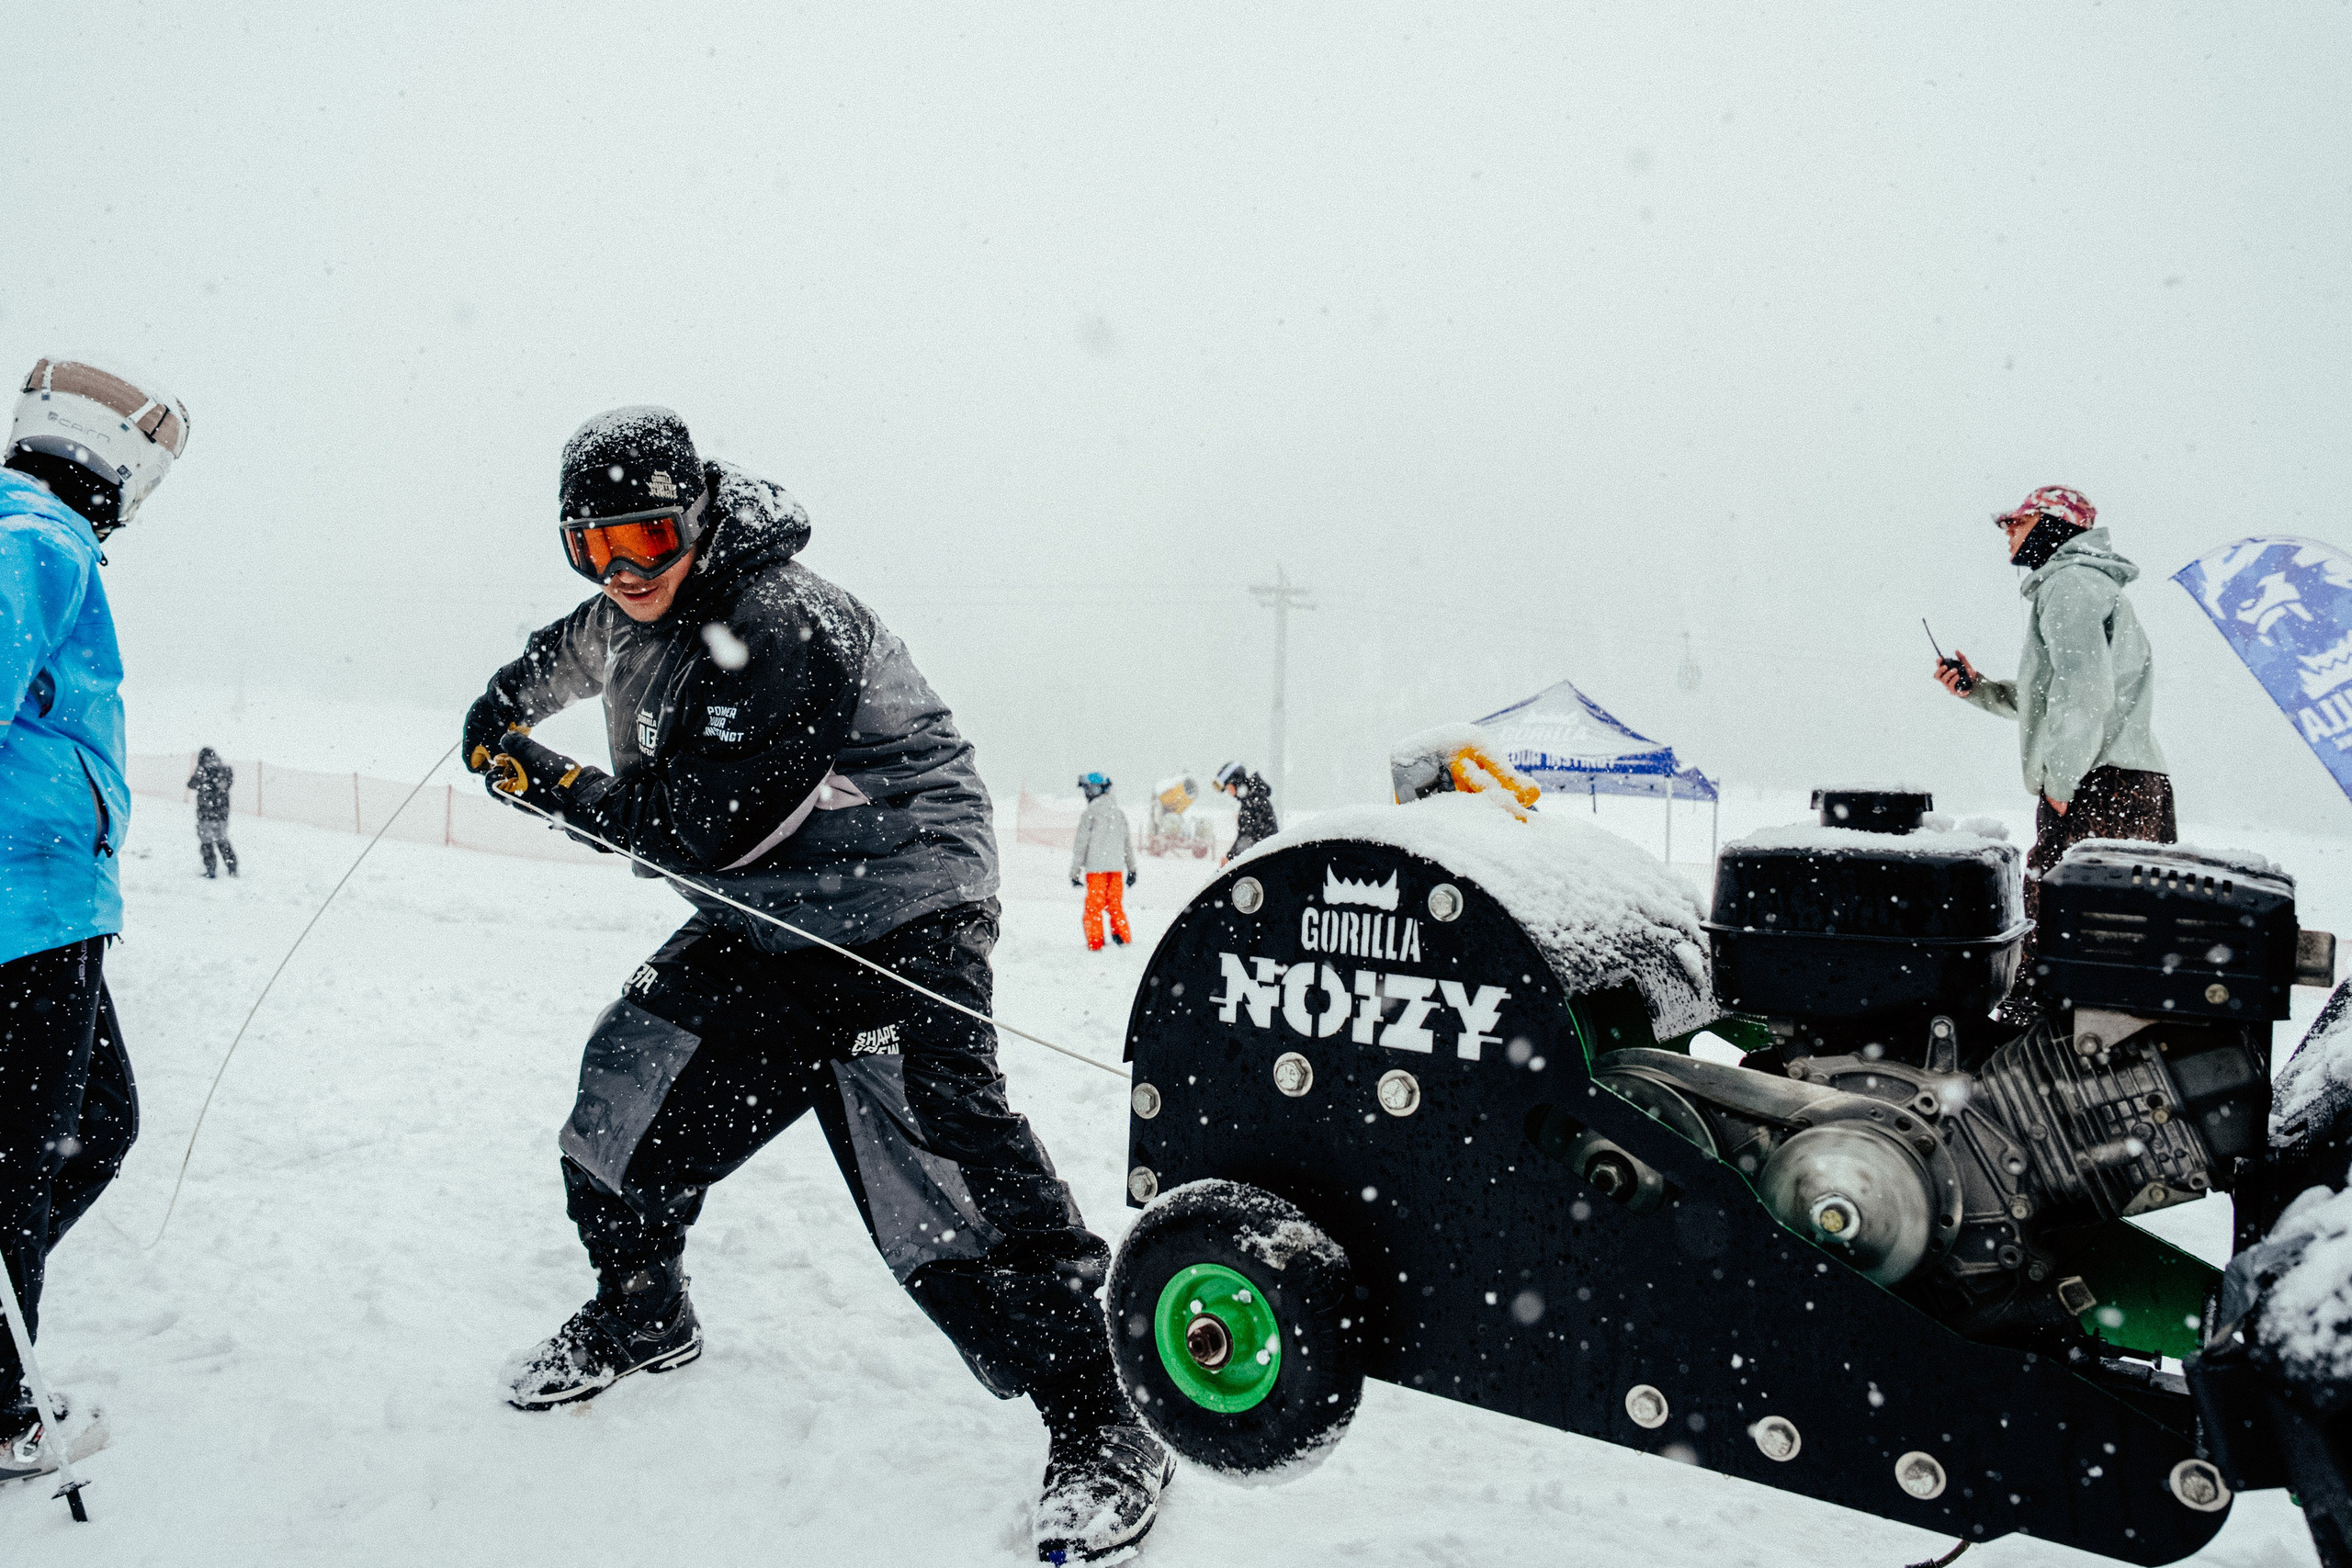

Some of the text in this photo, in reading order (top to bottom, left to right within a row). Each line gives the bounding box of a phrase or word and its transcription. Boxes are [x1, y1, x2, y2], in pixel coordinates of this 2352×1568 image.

[707, 705, 738, 719] POWER
[1300, 906, 1421, 963] GORILLA
[1208, 952, 1512, 1061] NOIZY
[854, 1023, 900, 1046] SHAPE
